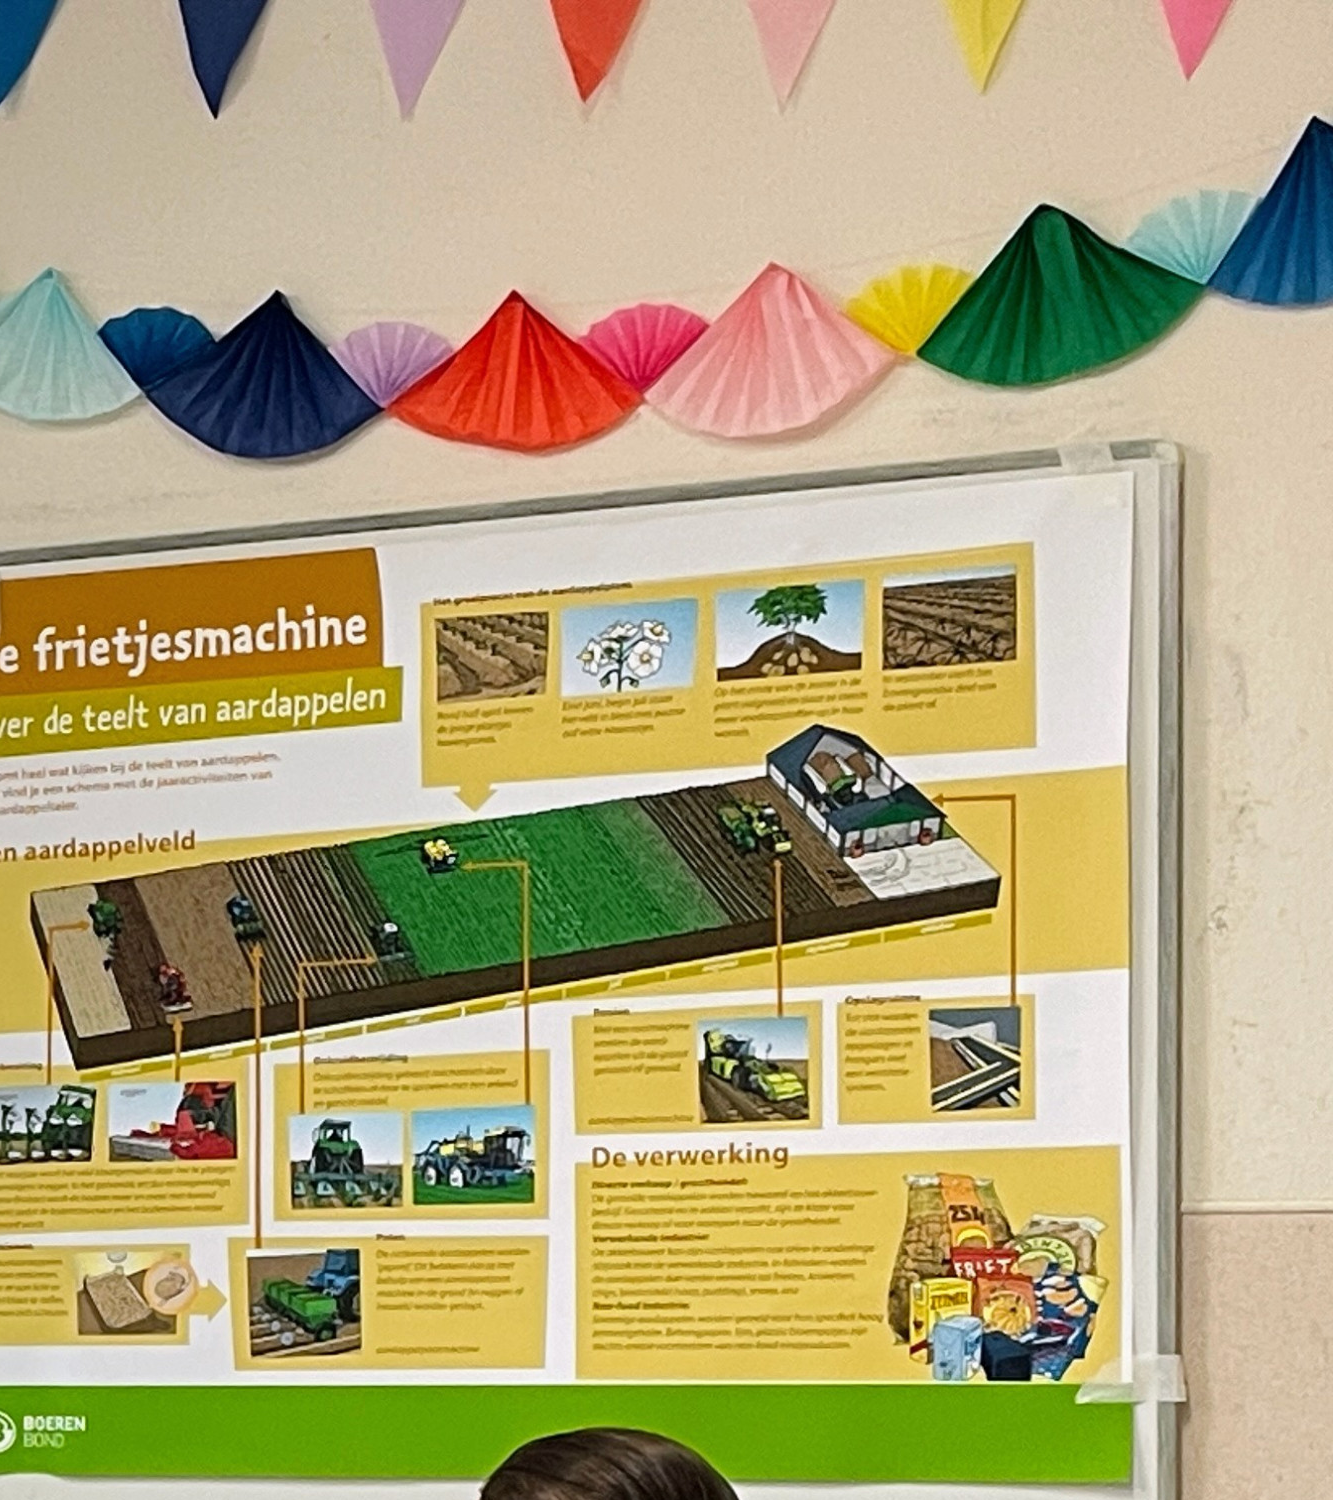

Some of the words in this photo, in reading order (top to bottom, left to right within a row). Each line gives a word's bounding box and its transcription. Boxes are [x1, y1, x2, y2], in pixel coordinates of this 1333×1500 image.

[33, 604, 368, 678] frietjesmachine
[42, 702, 73, 736] de
[82, 695, 150, 731] teelt
[159, 696, 208, 727] van
[216, 677, 387, 728] aardappelen
[24, 829, 196, 862] aardappelveld
[591, 1146, 628, 1169] De
[633, 1141, 789, 1170] verwerking
[23, 1415, 87, 1432] BOEREN
[23, 1433, 66, 1449] BOND
